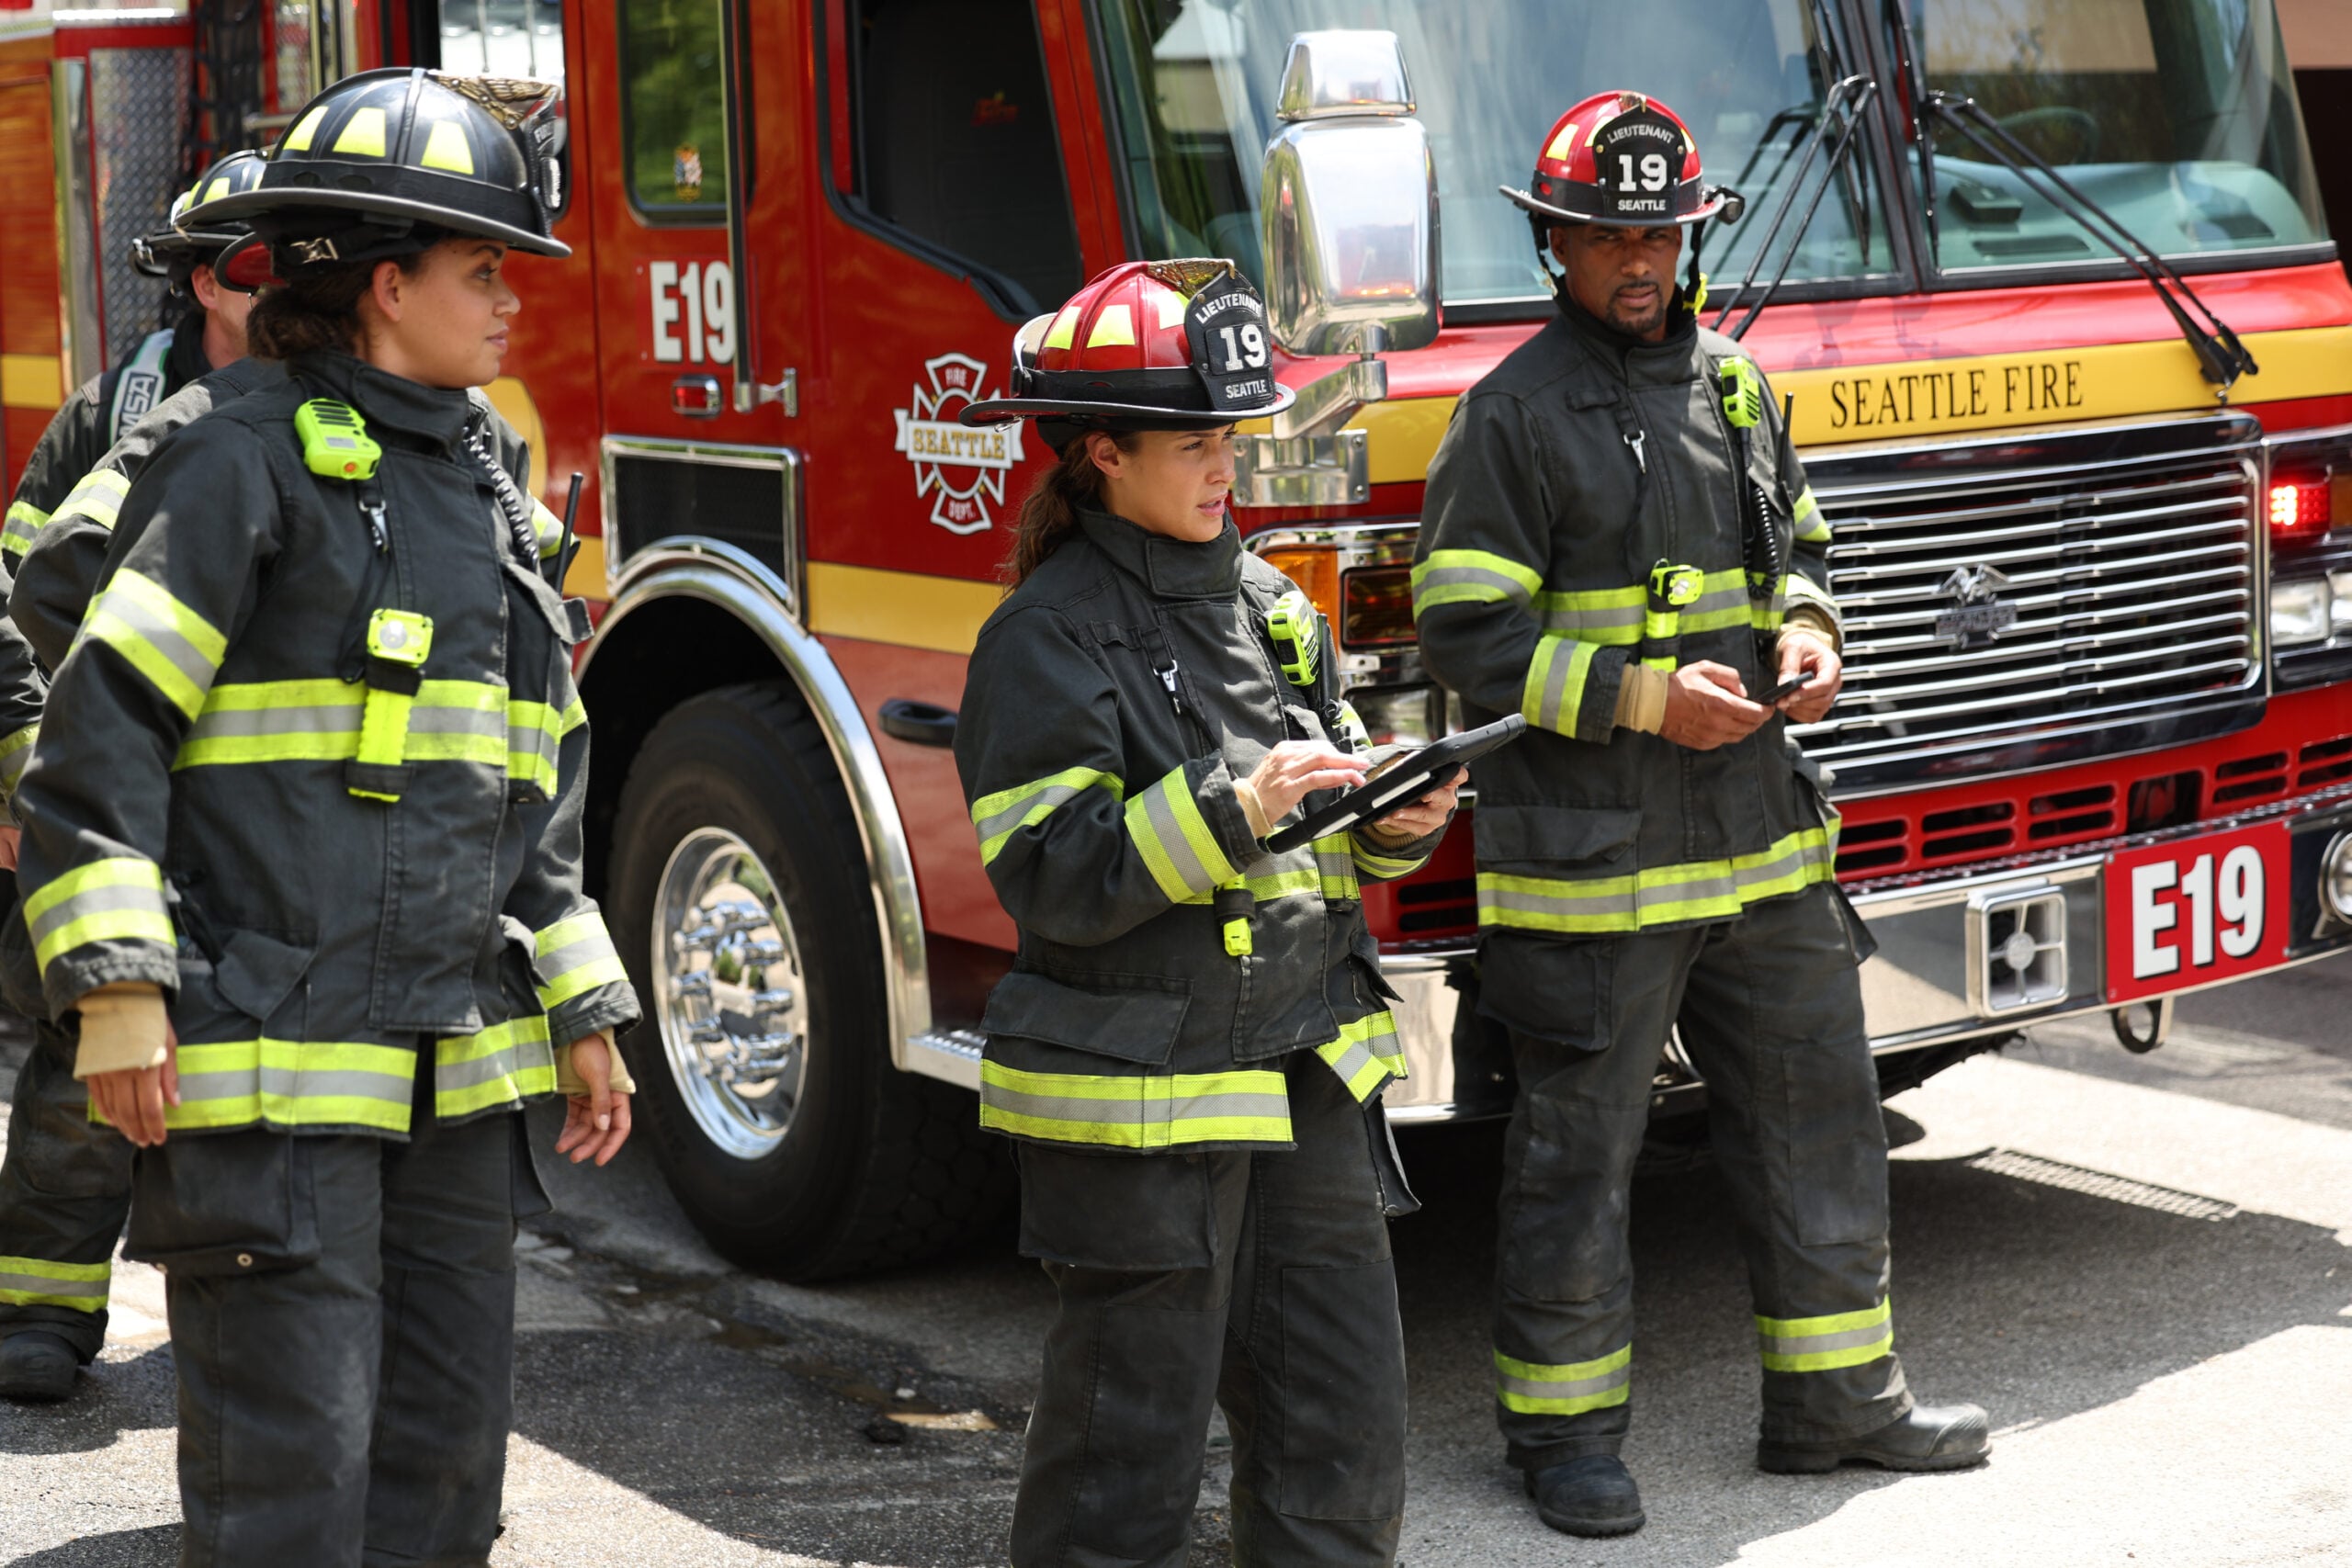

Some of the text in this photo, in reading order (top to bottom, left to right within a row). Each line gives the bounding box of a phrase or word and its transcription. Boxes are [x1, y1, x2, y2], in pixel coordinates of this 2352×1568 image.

[1607, 124, 1675, 144] LIEUTENANT
[1619, 153, 1668, 192] 19
[1617, 199, 1667, 211] SEATTLE
[650, 260, 736, 365] E19
[1194, 293, 1263, 324] LIEUTENANT
[1219, 323, 1266, 372] 19
[944, 367, 968, 388] FIRE
[1226, 379, 1267, 399] SEATTLE
[1829, 360, 2084, 429] SEATTLE FIRE
[912, 427, 1006, 460] SEATTLE
[2131, 844, 2267, 981] E19
